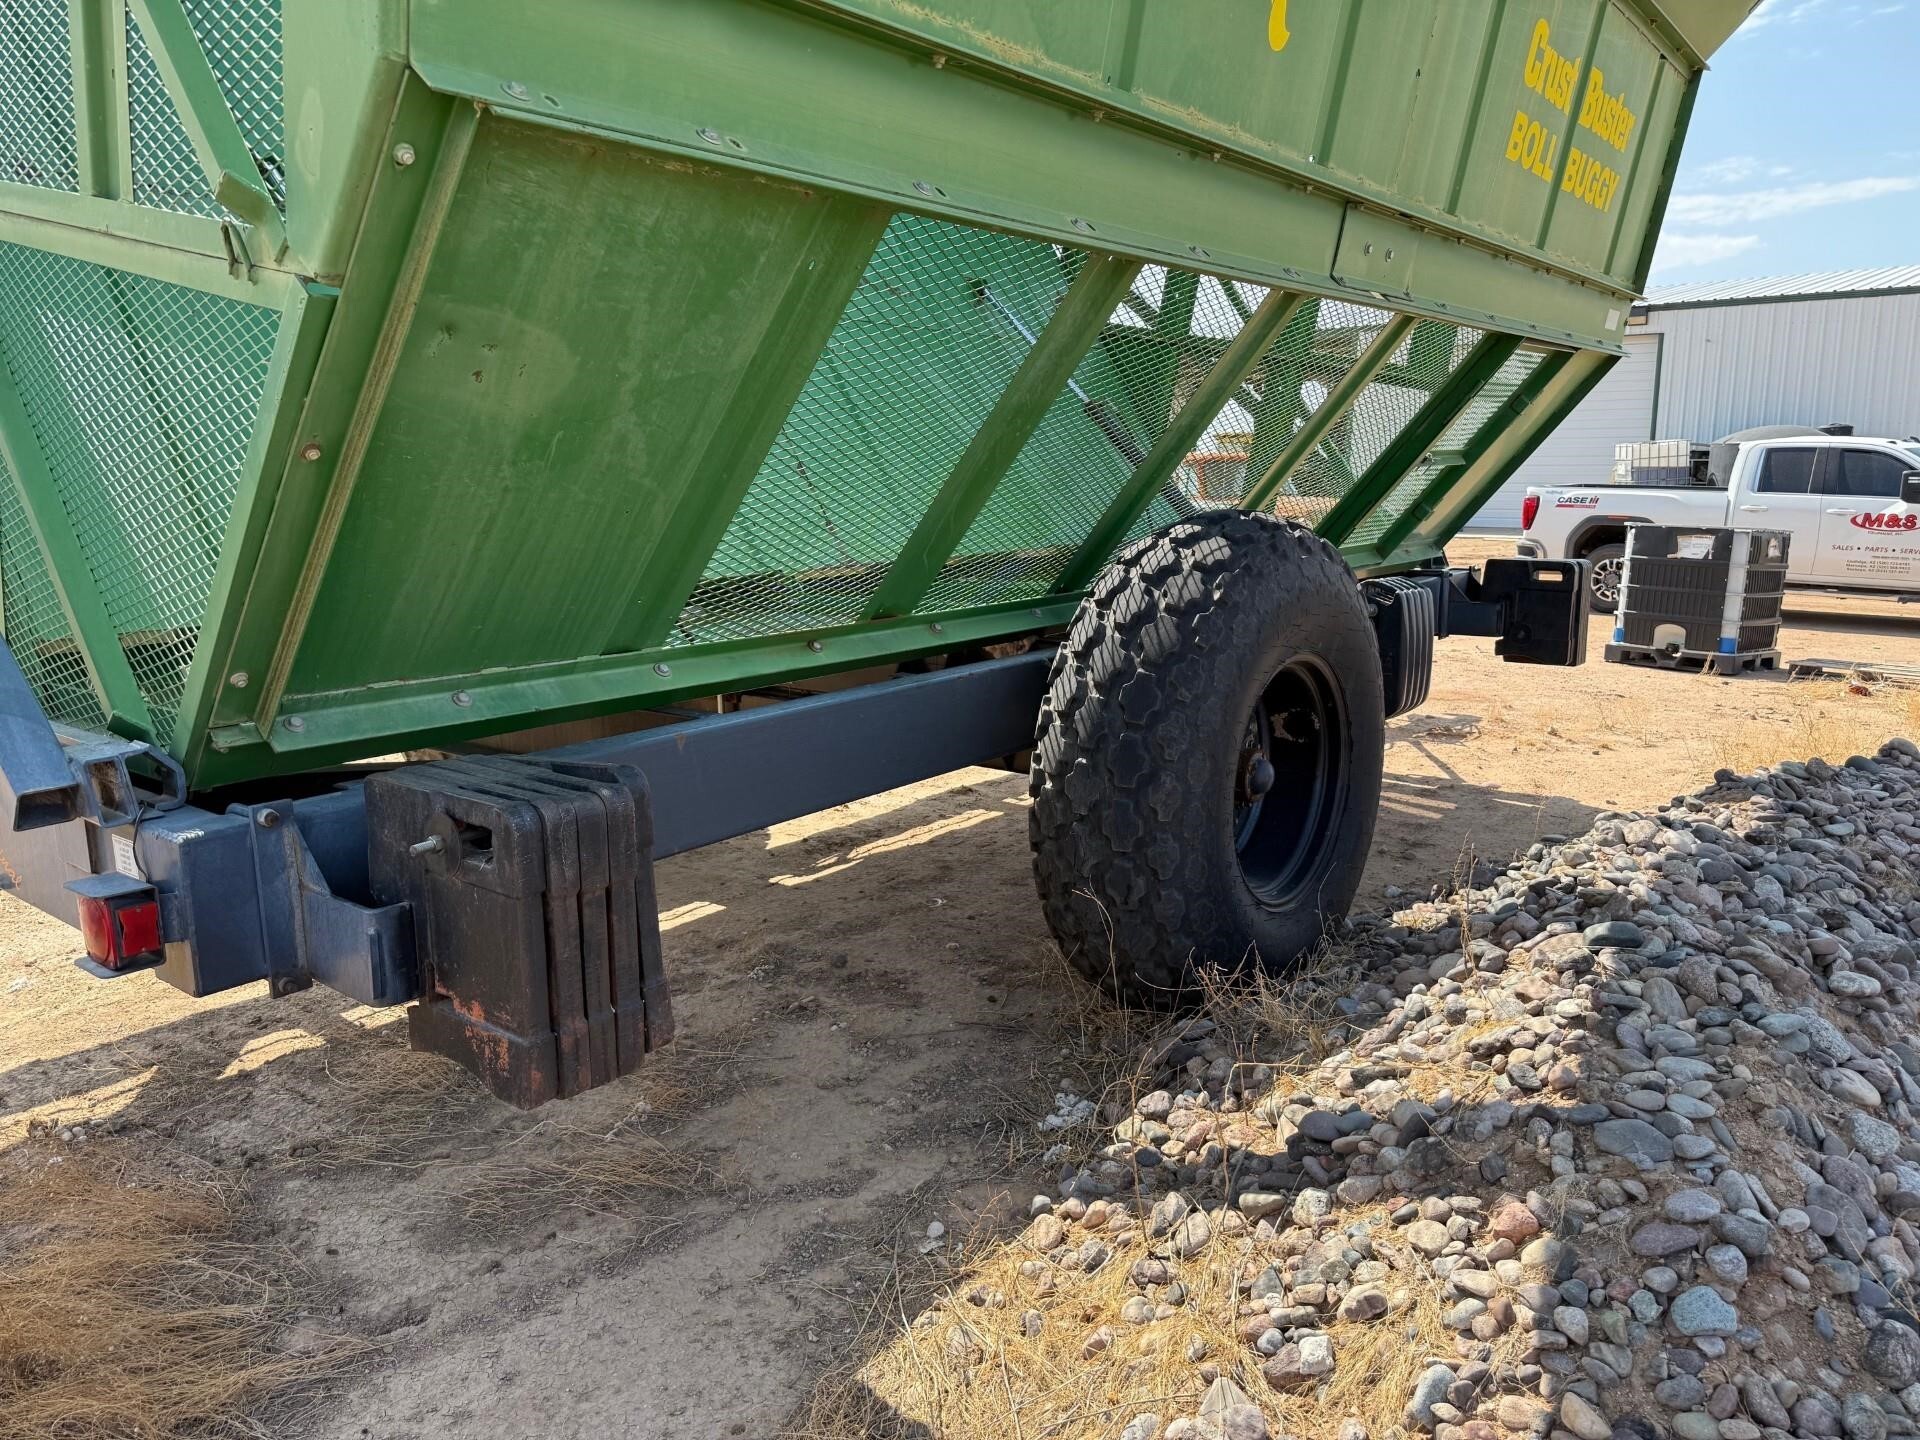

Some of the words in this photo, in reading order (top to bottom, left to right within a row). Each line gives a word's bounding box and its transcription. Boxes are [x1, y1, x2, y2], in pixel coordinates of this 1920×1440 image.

[1524, 18, 1582, 116] Crust
[1577, 66, 1637, 153] Buster
[1505, 111, 1558, 184] BOLL
[1561, 147, 1621, 213] BUGGY
[1557, 496, 1589, 504] CASE
